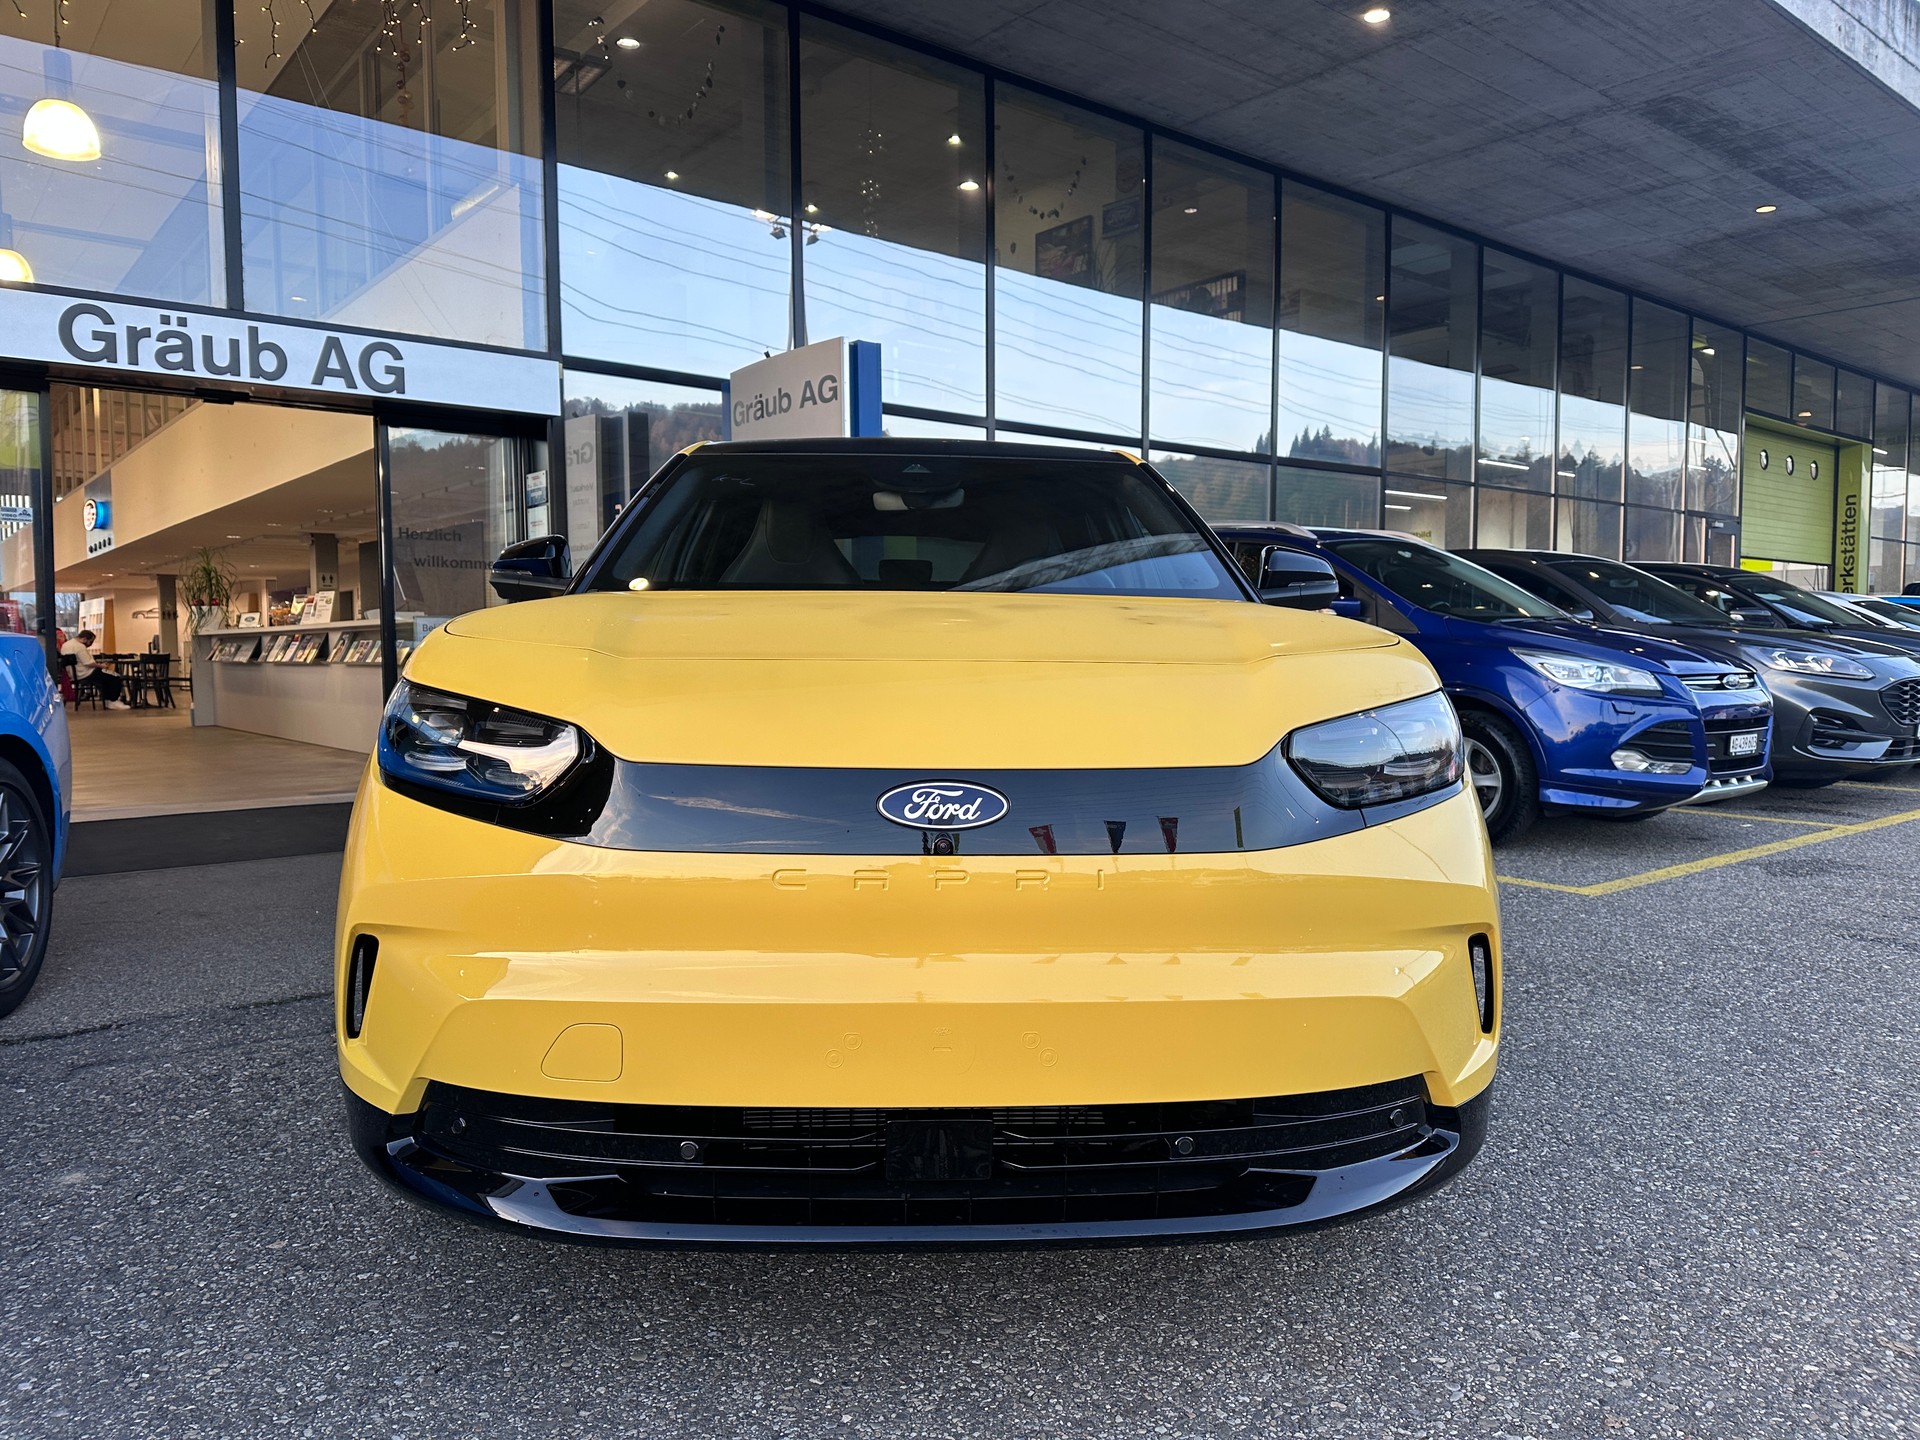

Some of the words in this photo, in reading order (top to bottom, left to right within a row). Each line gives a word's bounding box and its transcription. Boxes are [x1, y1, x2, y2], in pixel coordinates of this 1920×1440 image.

[58, 303, 287, 381] Gräub
[311, 336, 406, 395] AG
[733, 387, 792, 428] Gräub
[799, 374, 838, 409] AG
[398, 527, 462, 542] Herzlich
[903, 787, 983, 822] Ford
[771, 867, 1106, 892] CAPRI
